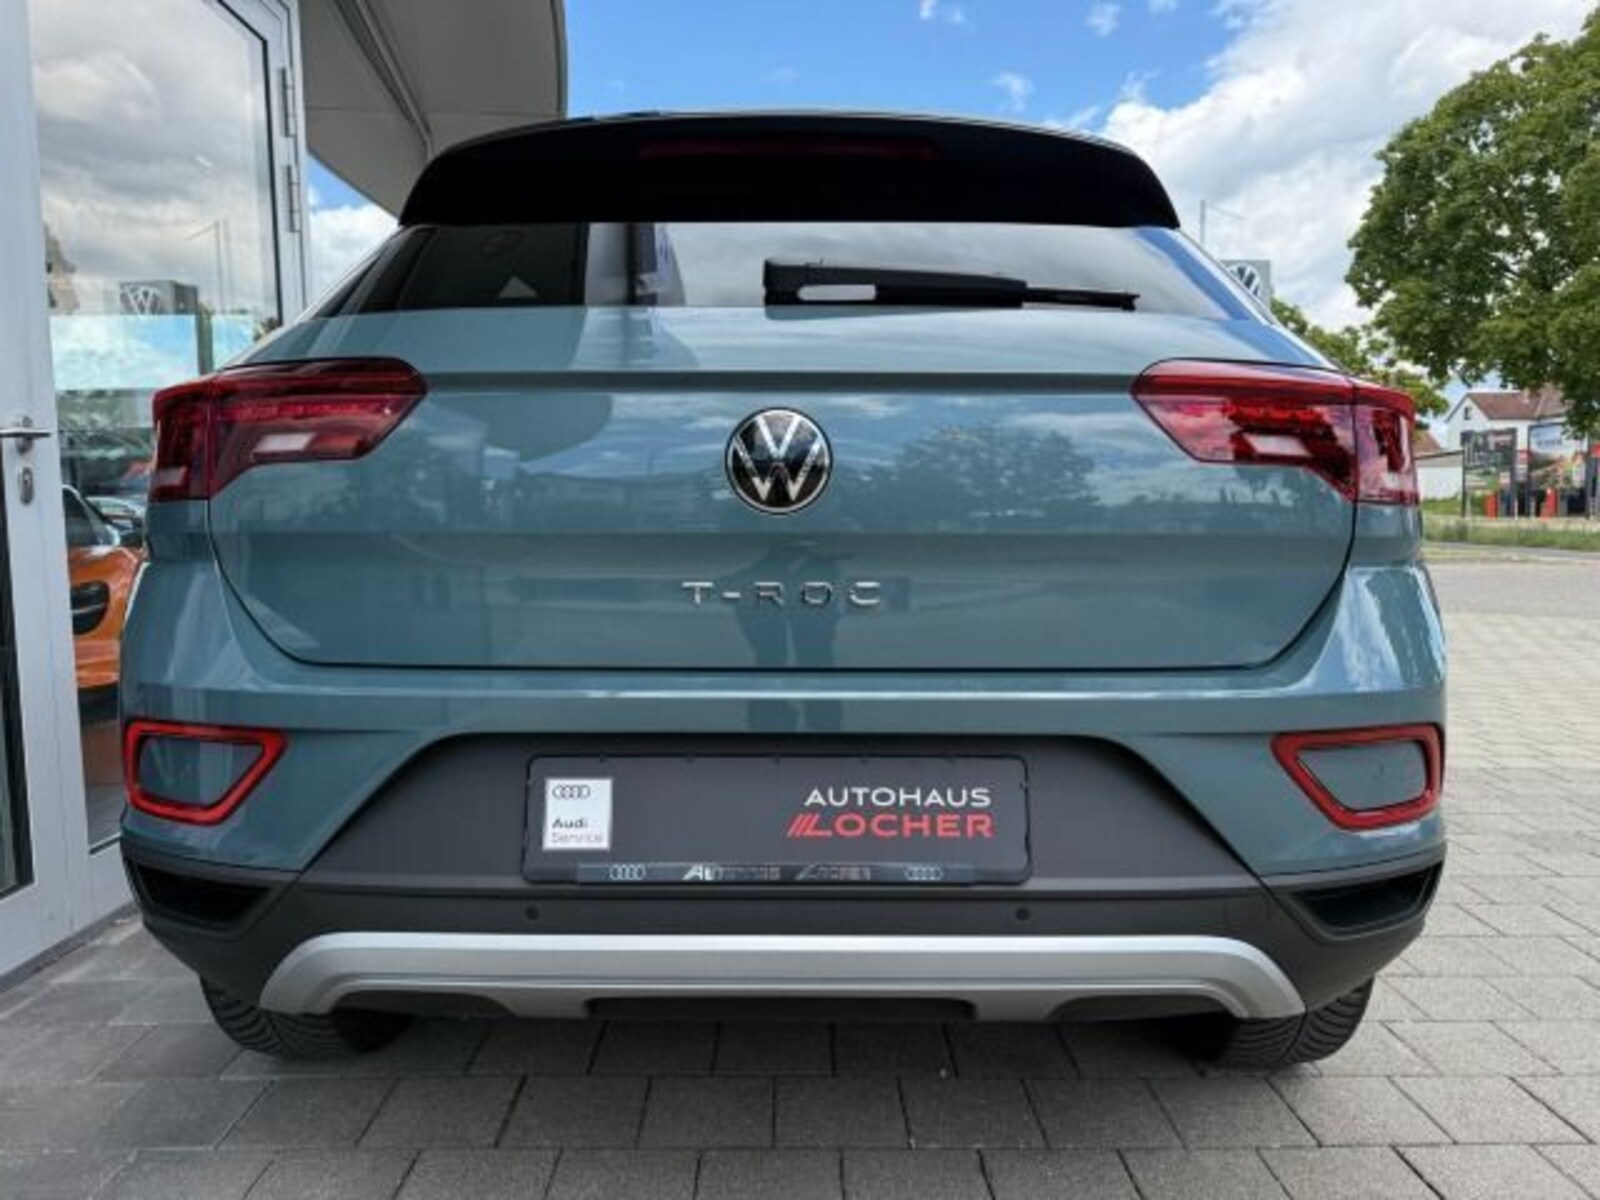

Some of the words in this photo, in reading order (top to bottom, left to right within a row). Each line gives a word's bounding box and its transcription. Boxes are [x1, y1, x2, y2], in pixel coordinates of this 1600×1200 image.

[682, 581, 881, 605] T-ROC
[804, 786, 992, 808] AUTOHAUS
[552, 817, 588, 829] Audi
[788, 812, 995, 838] LOCHER
